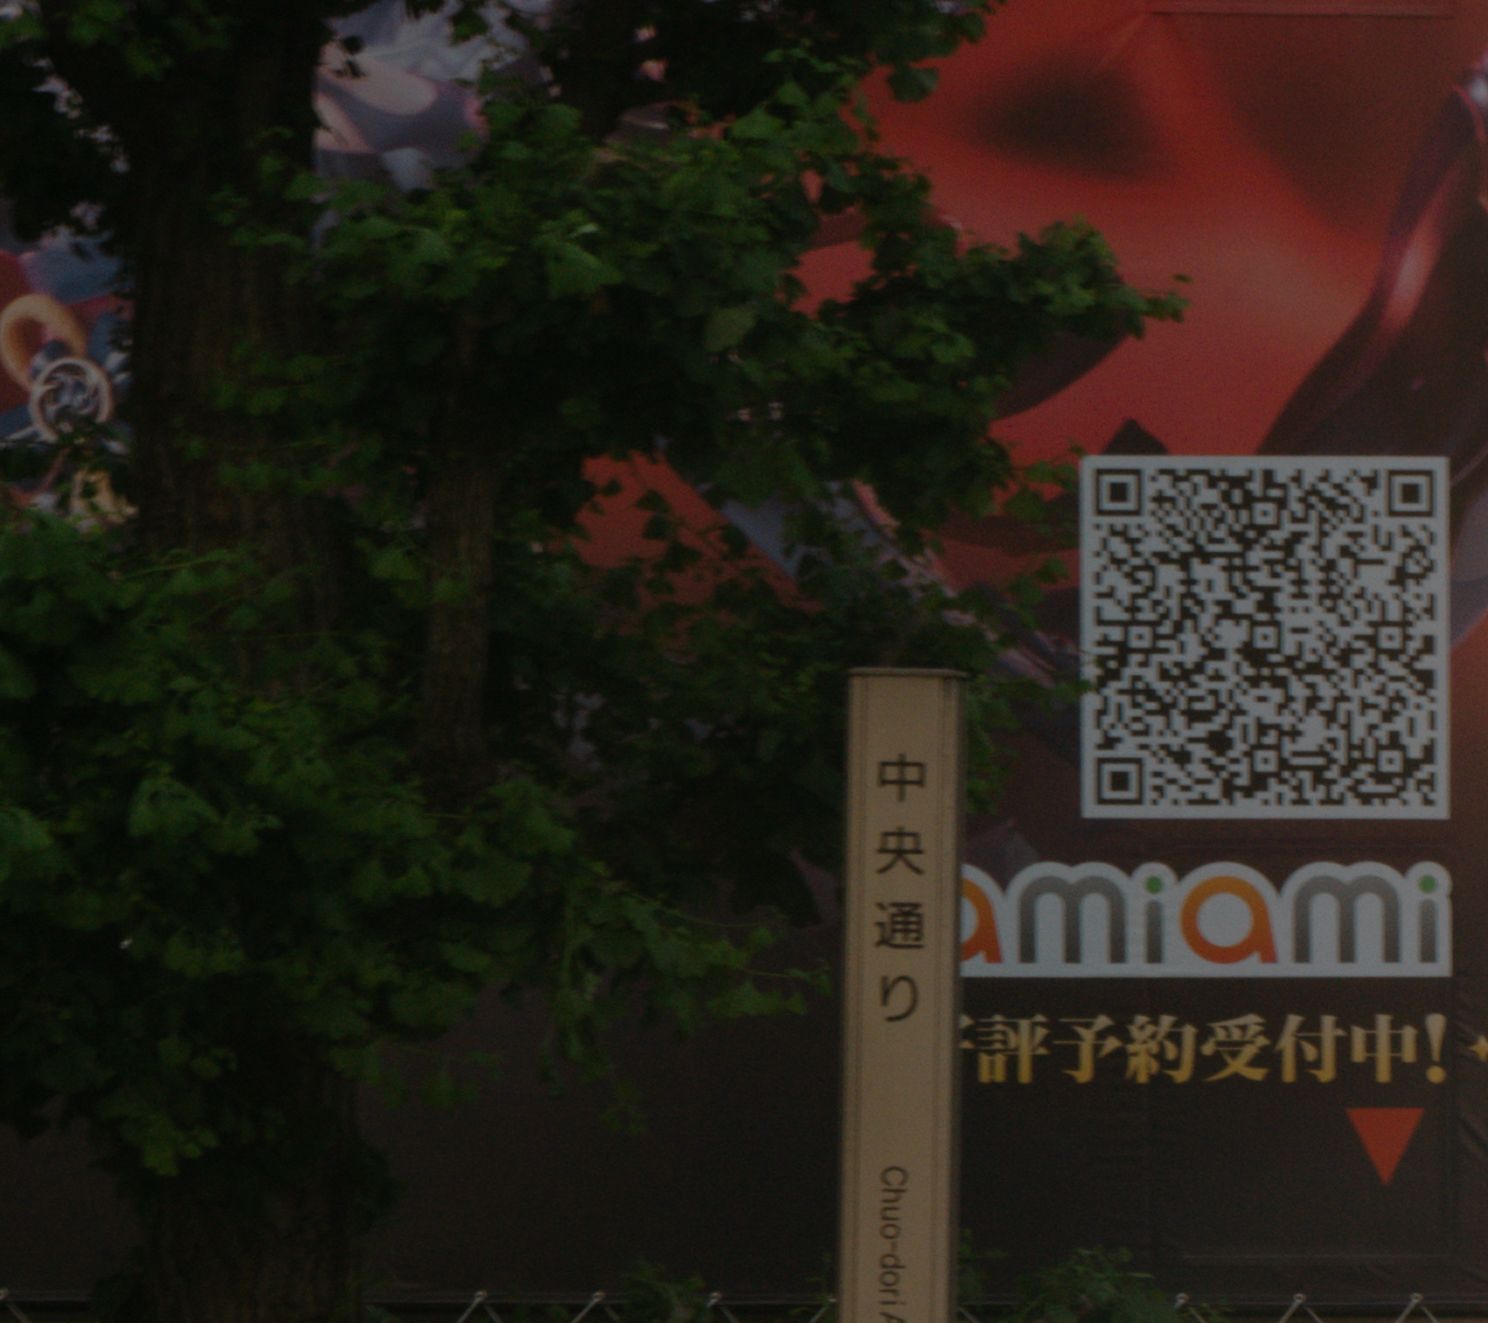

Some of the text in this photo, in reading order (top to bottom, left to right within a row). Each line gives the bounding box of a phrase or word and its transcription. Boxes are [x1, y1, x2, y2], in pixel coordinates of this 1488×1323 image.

[873, 754, 927, 1024] 中央通り
[960, 1013, 1448, 1085] 評予約受付中!
[878, 1165, 909, 1306] Chuo-dori
